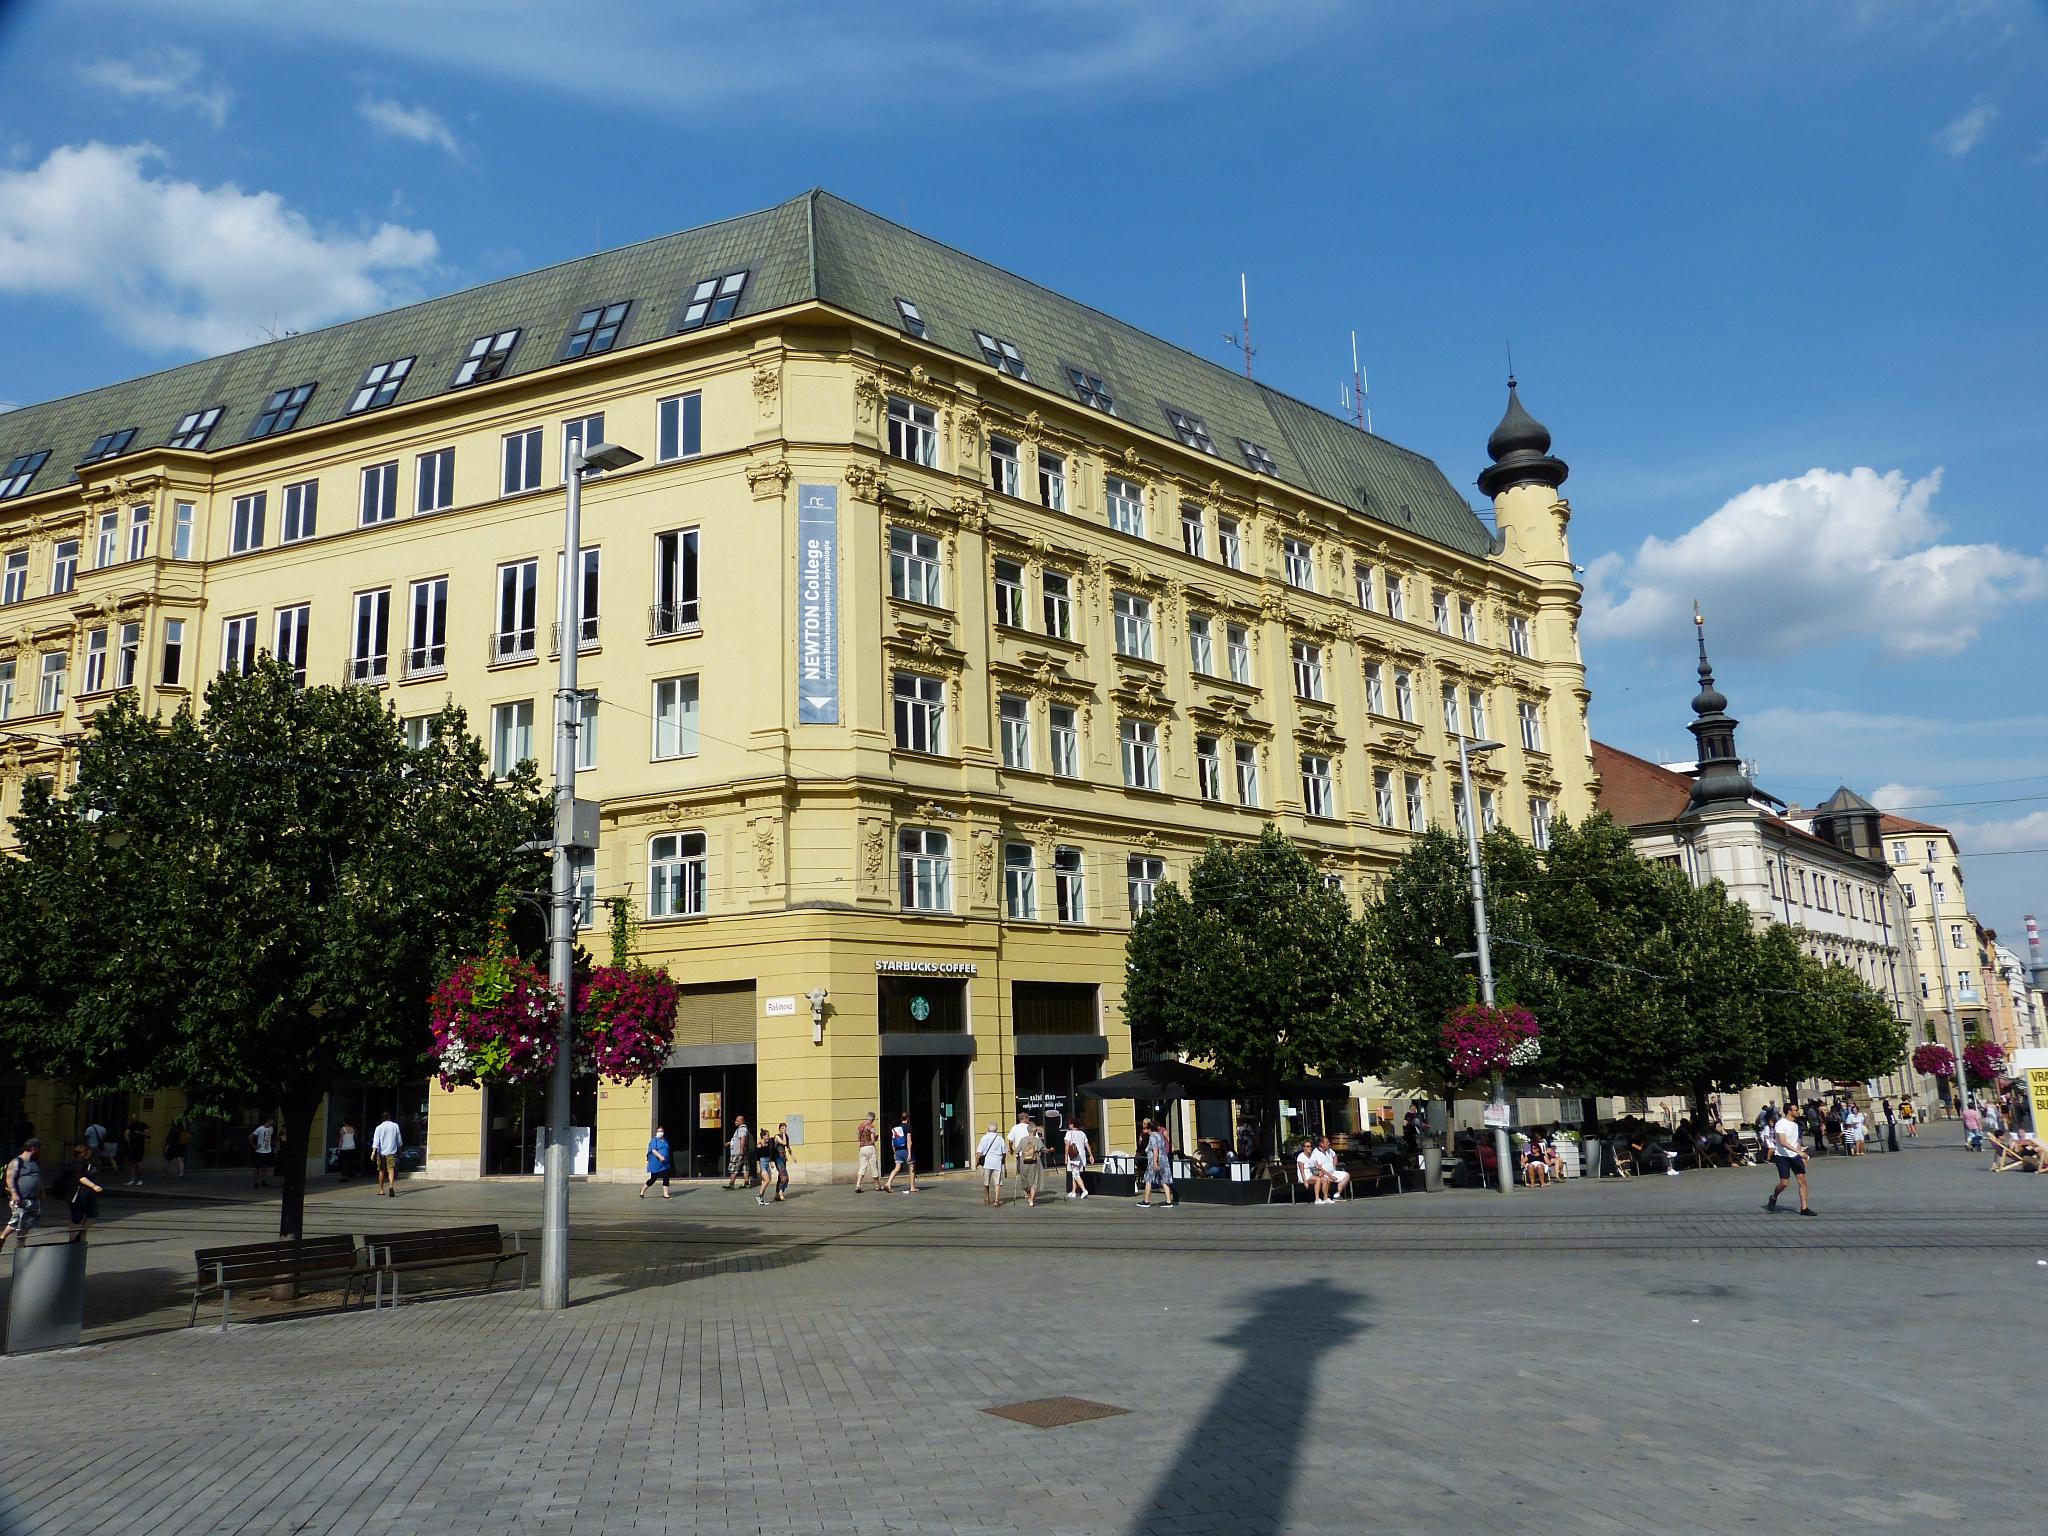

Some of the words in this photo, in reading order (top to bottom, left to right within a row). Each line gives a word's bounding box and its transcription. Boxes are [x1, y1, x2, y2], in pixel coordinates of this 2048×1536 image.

[804, 539, 823, 601] College
[823, 540, 832, 580] psychologie
[823, 586, 832, 635] managementu
[804, 605, 820, 680] NEWTON
[823, 636, 831, 655] škola
[823, 655, 832, 680] vysoká
[875, 960, 938, 972] STARBUCKS
[939, 963, 977, 973] COFFEE
